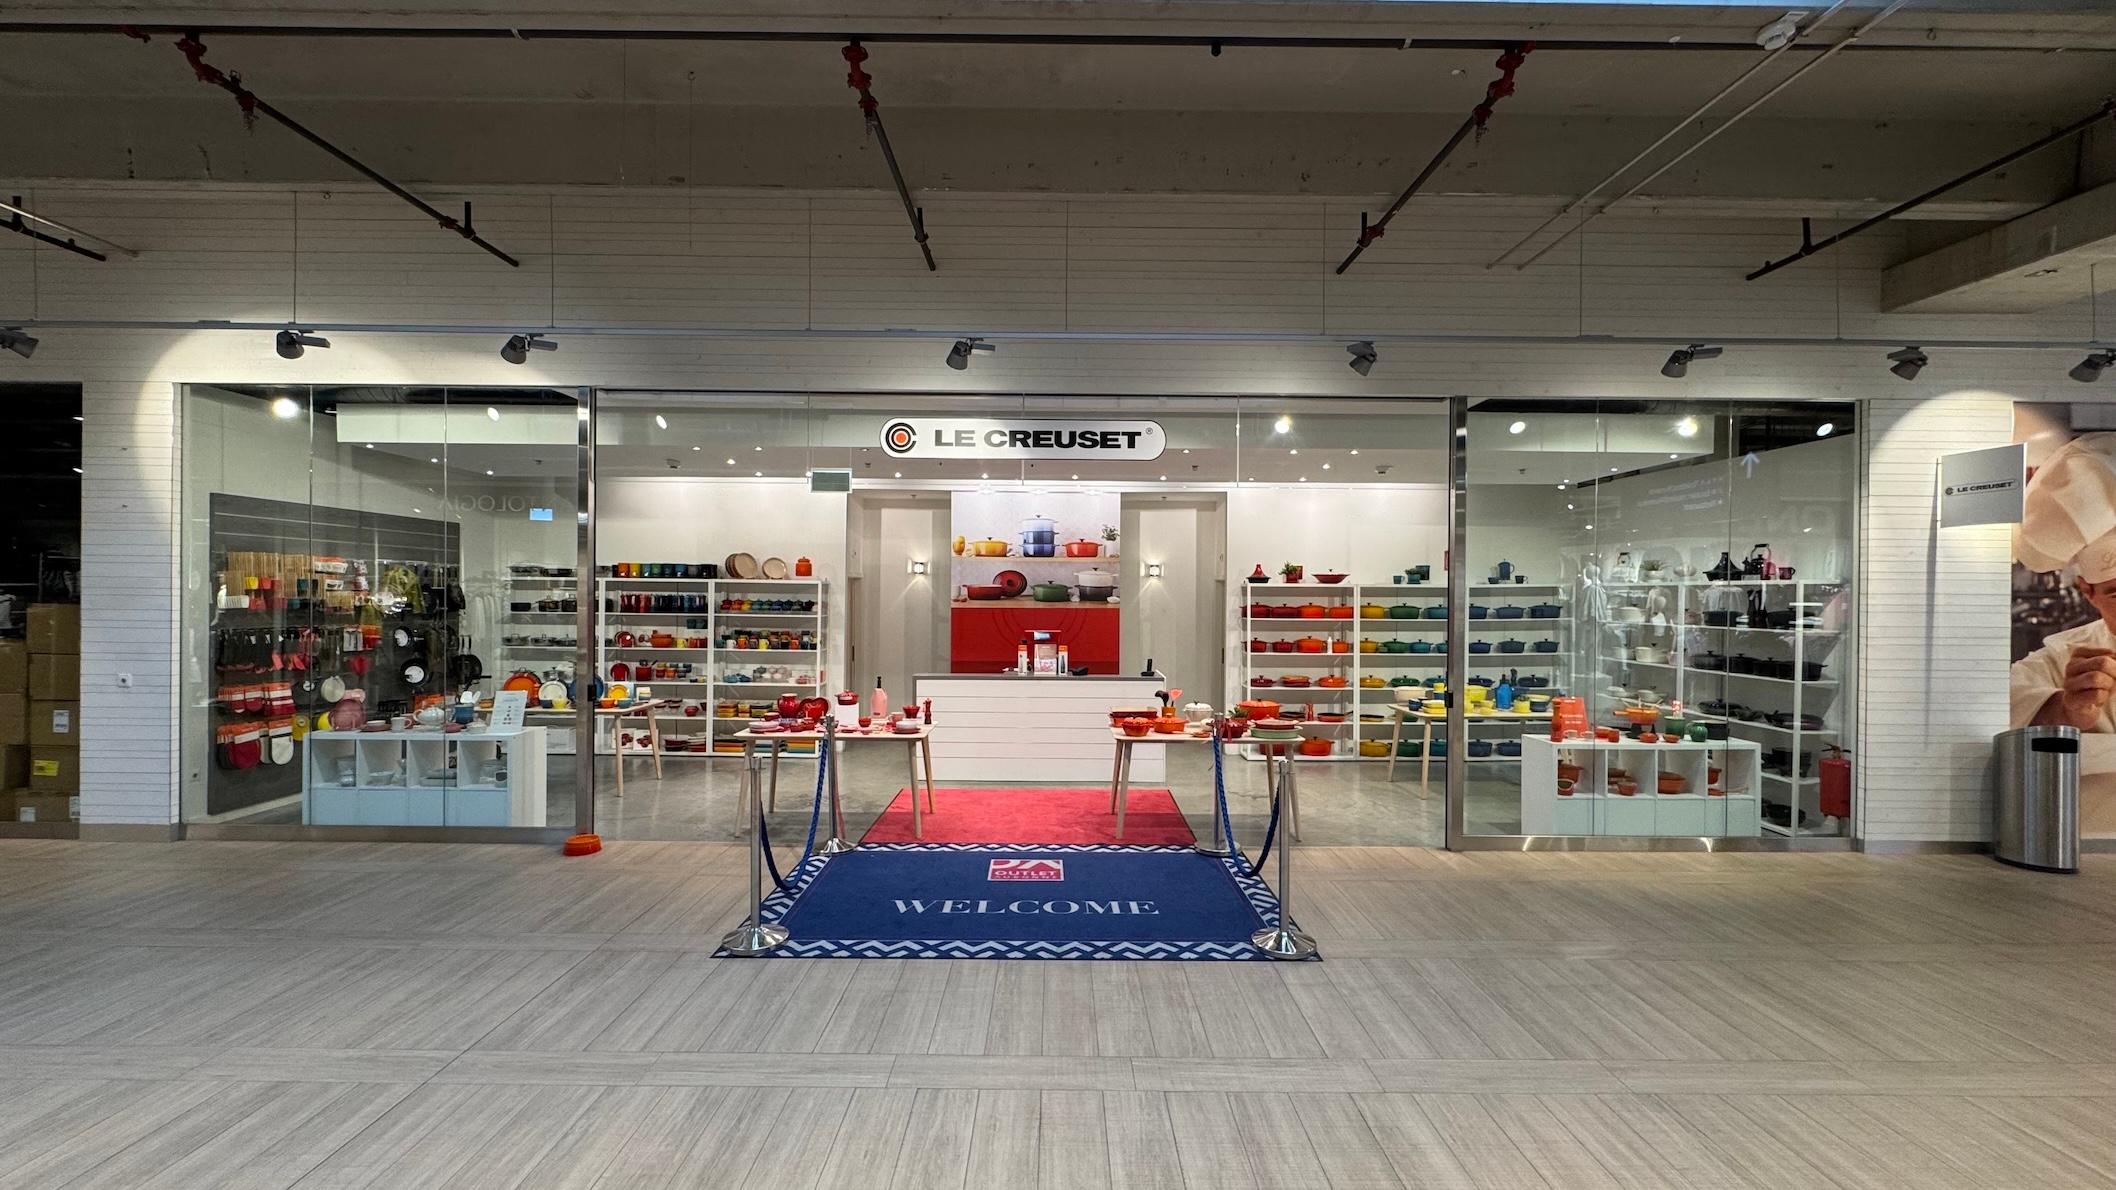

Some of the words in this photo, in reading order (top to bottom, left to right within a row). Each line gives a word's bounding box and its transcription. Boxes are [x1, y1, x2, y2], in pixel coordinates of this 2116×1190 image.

[934, 429, 976, 447] LE
[983, 429, 1141, 449] CREUSET
[1970, 481, 2014, 492] CREUSET
[894, 899, 1160, 915] WELCOME
